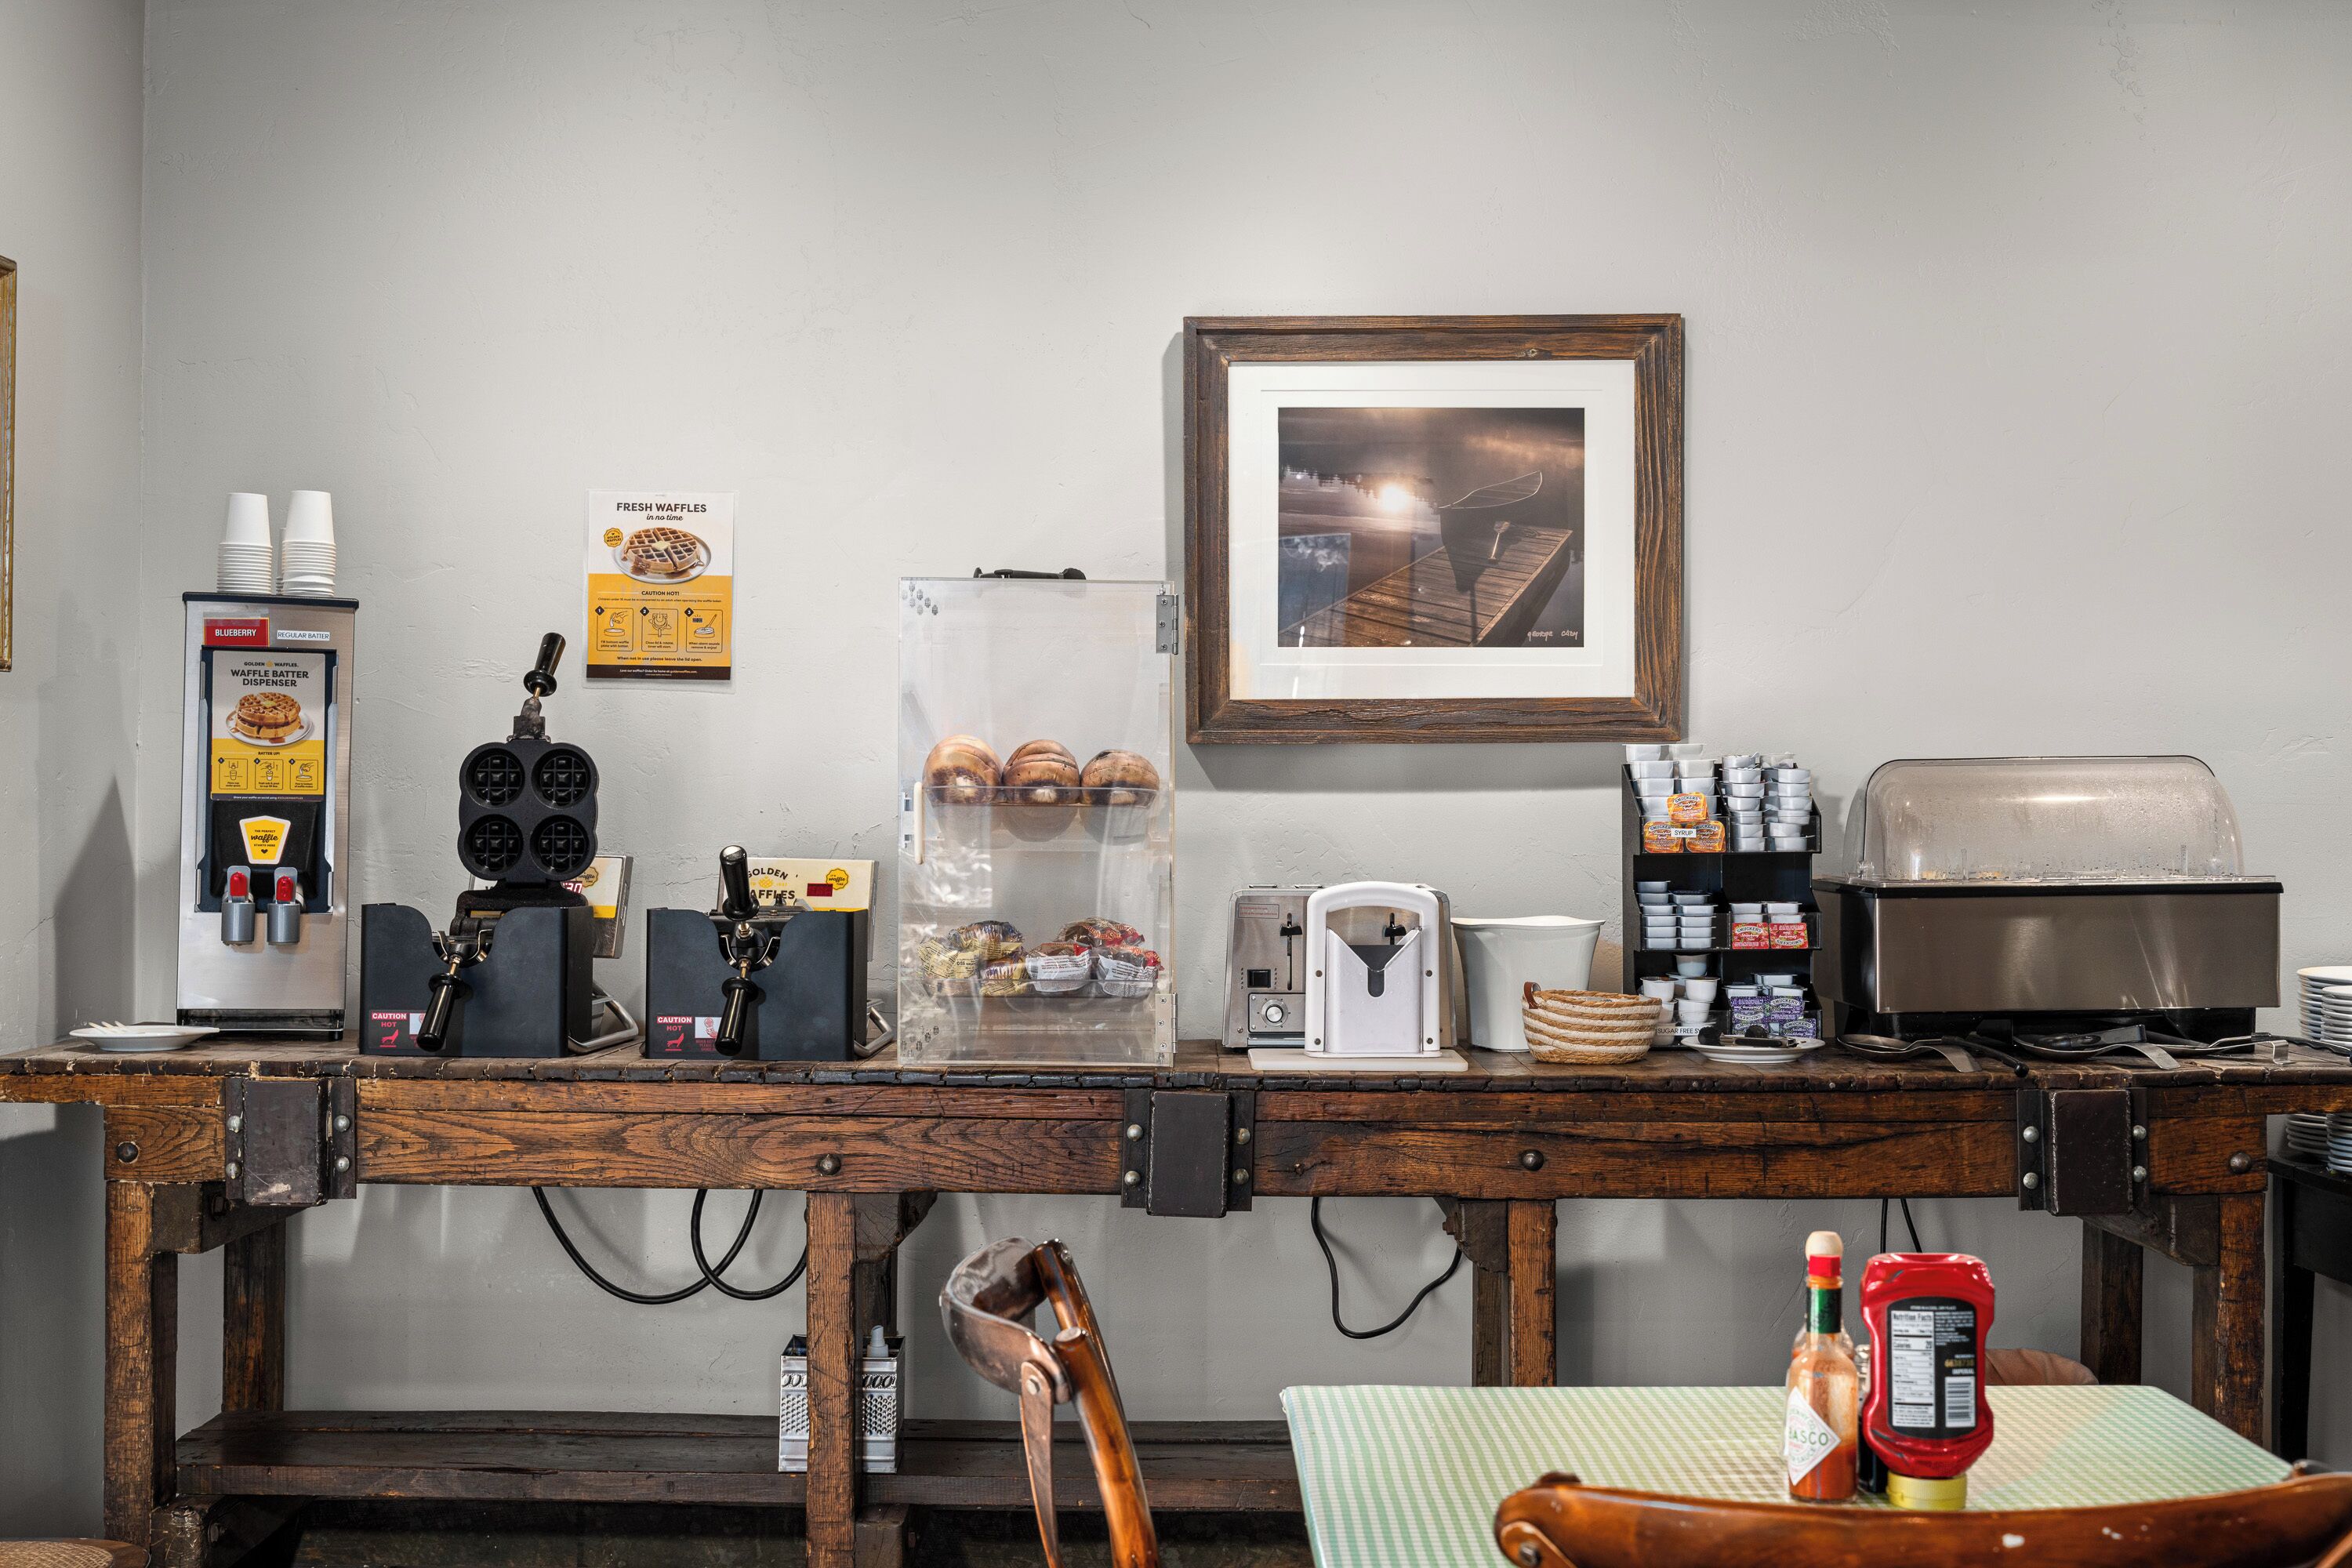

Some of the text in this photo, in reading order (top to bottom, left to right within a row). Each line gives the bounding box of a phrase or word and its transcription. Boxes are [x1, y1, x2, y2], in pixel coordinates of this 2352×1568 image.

[616, 503, 707, 513] FRESH WAFFLES
[272, 670, 309, 679] BATTER
[243, 678, 297, 687] DISPENSER
[251, 834, 278, 843] waffle
[750, 890, 796, 899] AFFLES
